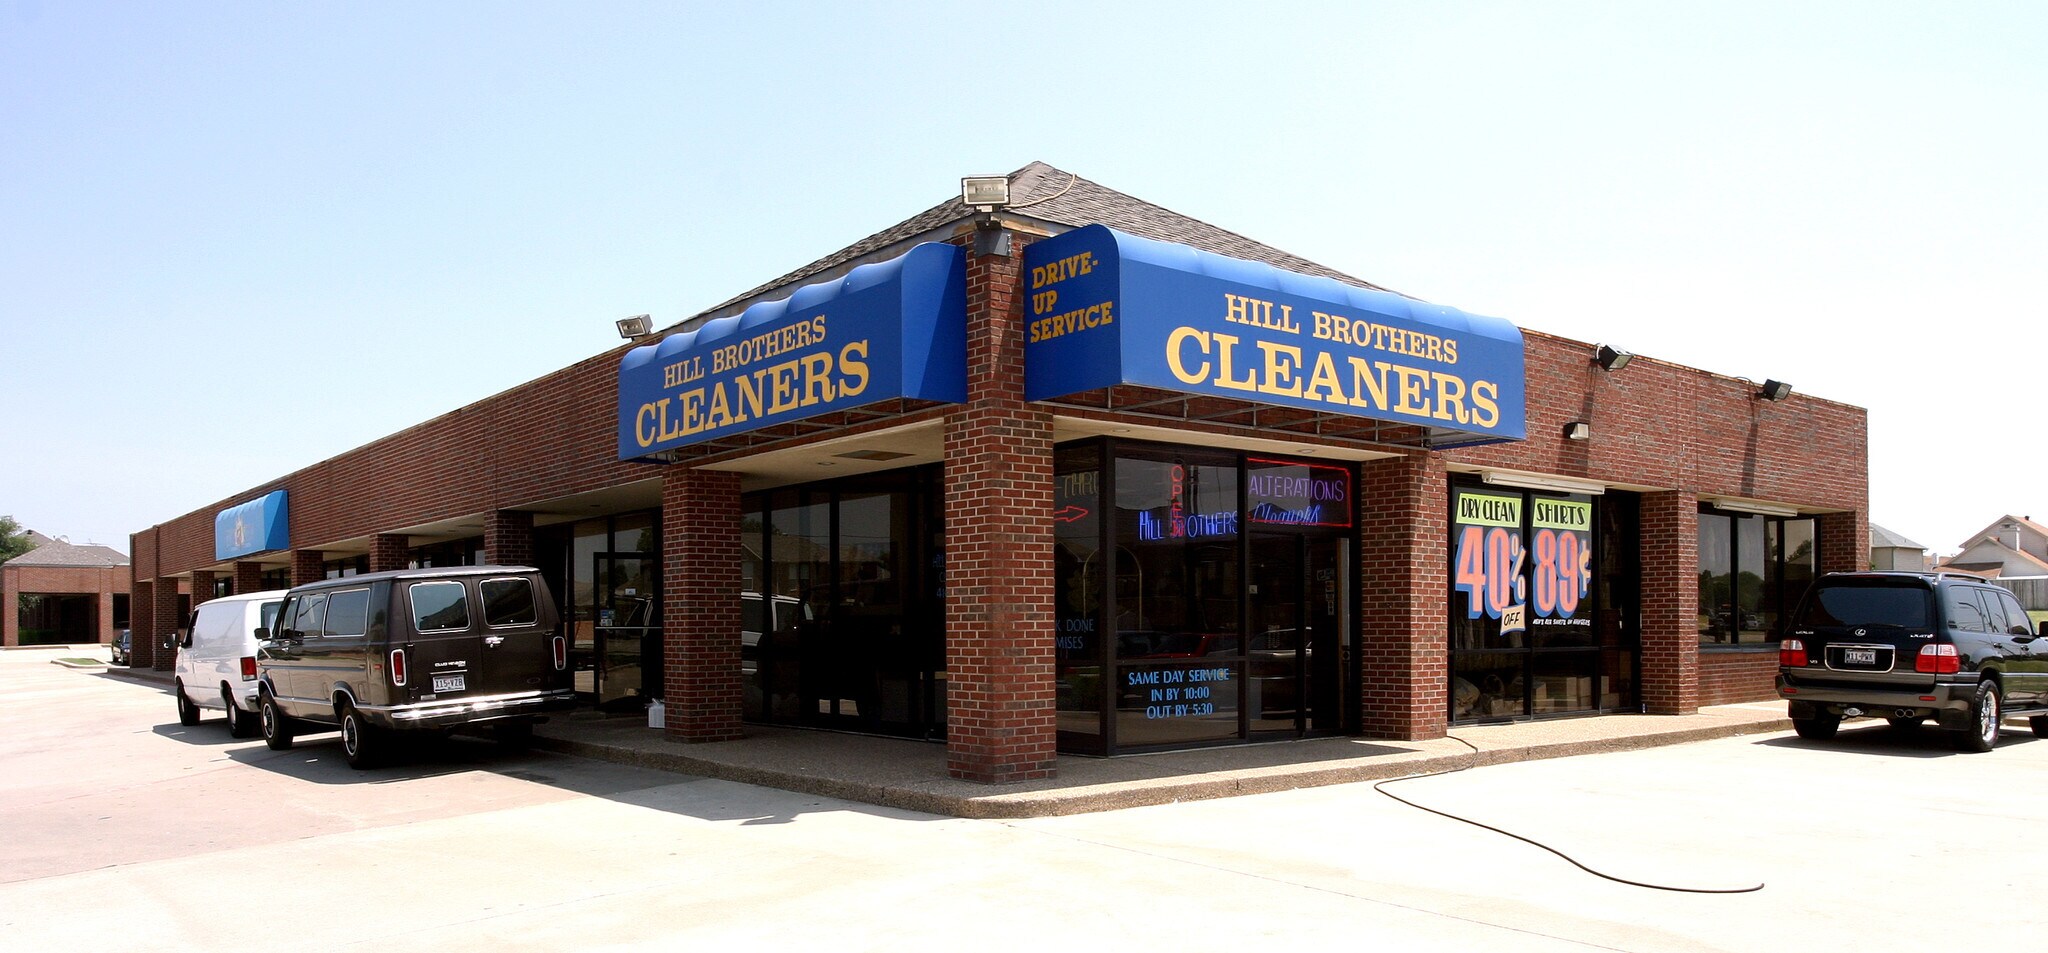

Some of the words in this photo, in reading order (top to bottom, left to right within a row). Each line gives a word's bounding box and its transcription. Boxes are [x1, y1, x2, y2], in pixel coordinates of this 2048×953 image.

[1032, 251, 1098, 289] DRIVE-
[1033, 292, 1058, 315] UP
[1030, 301, 1113, 343] SERVICE
[1225, 293, 1300, 335] HILL
[1312, 311, 1458, 365] BROTHERS
[664, 356, 705, 389] HILL
[712, 315, 826, 375] BROTHERS
[1166, 326, 1499, 429] CLEANERS
[635, 339, 869, 447] CLEANERS
[1249, 474, 1344, 502] ALTERATIONS
[1461, 497, 1481, 519] DRY
[1482, 500, 1515, 522] CLEAN
[1536, 503, 1585, 525] SHIRTS
[1139, 511, 1165, 541] HILL
[1455, 525, 1526, 619] 40%
[1533, 529, 1591, 618] 89¢
[1066, 618, 1095, 632] DONE
[1503, 611, 1521, 626] OFF
[1128, 671, 1160, 686] SAME
[1163, 669, 1184, 683] DAY
[1188, 668, 1229, 682] SERVICE
[1151, 688, 1163, 702] IN
[1166, 687, 1180, 701] BY
[1183, 686, 1209, 700] 10:00
[1146, 705, 1171, 719] OUT
[1175, 704, 1188, 717] BY
[1192, 702, 1213, 716] 5:30
